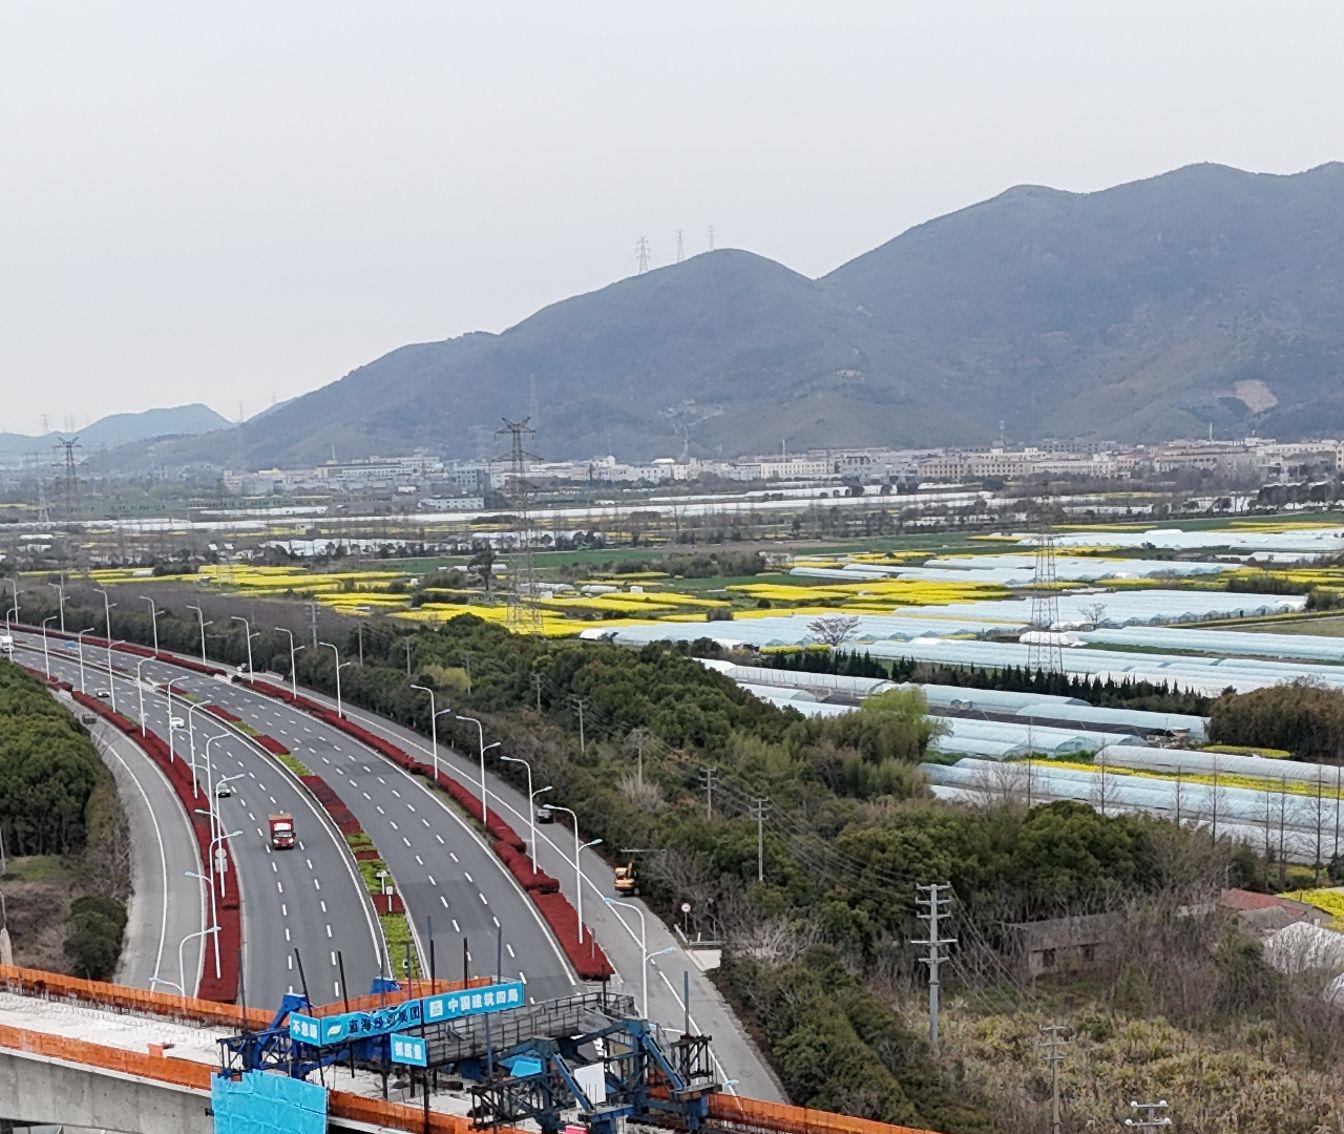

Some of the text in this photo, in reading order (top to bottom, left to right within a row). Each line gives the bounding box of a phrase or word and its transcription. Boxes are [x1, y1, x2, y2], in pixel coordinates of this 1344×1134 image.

[447, 988, 519, 1013] 中国建筑四局
